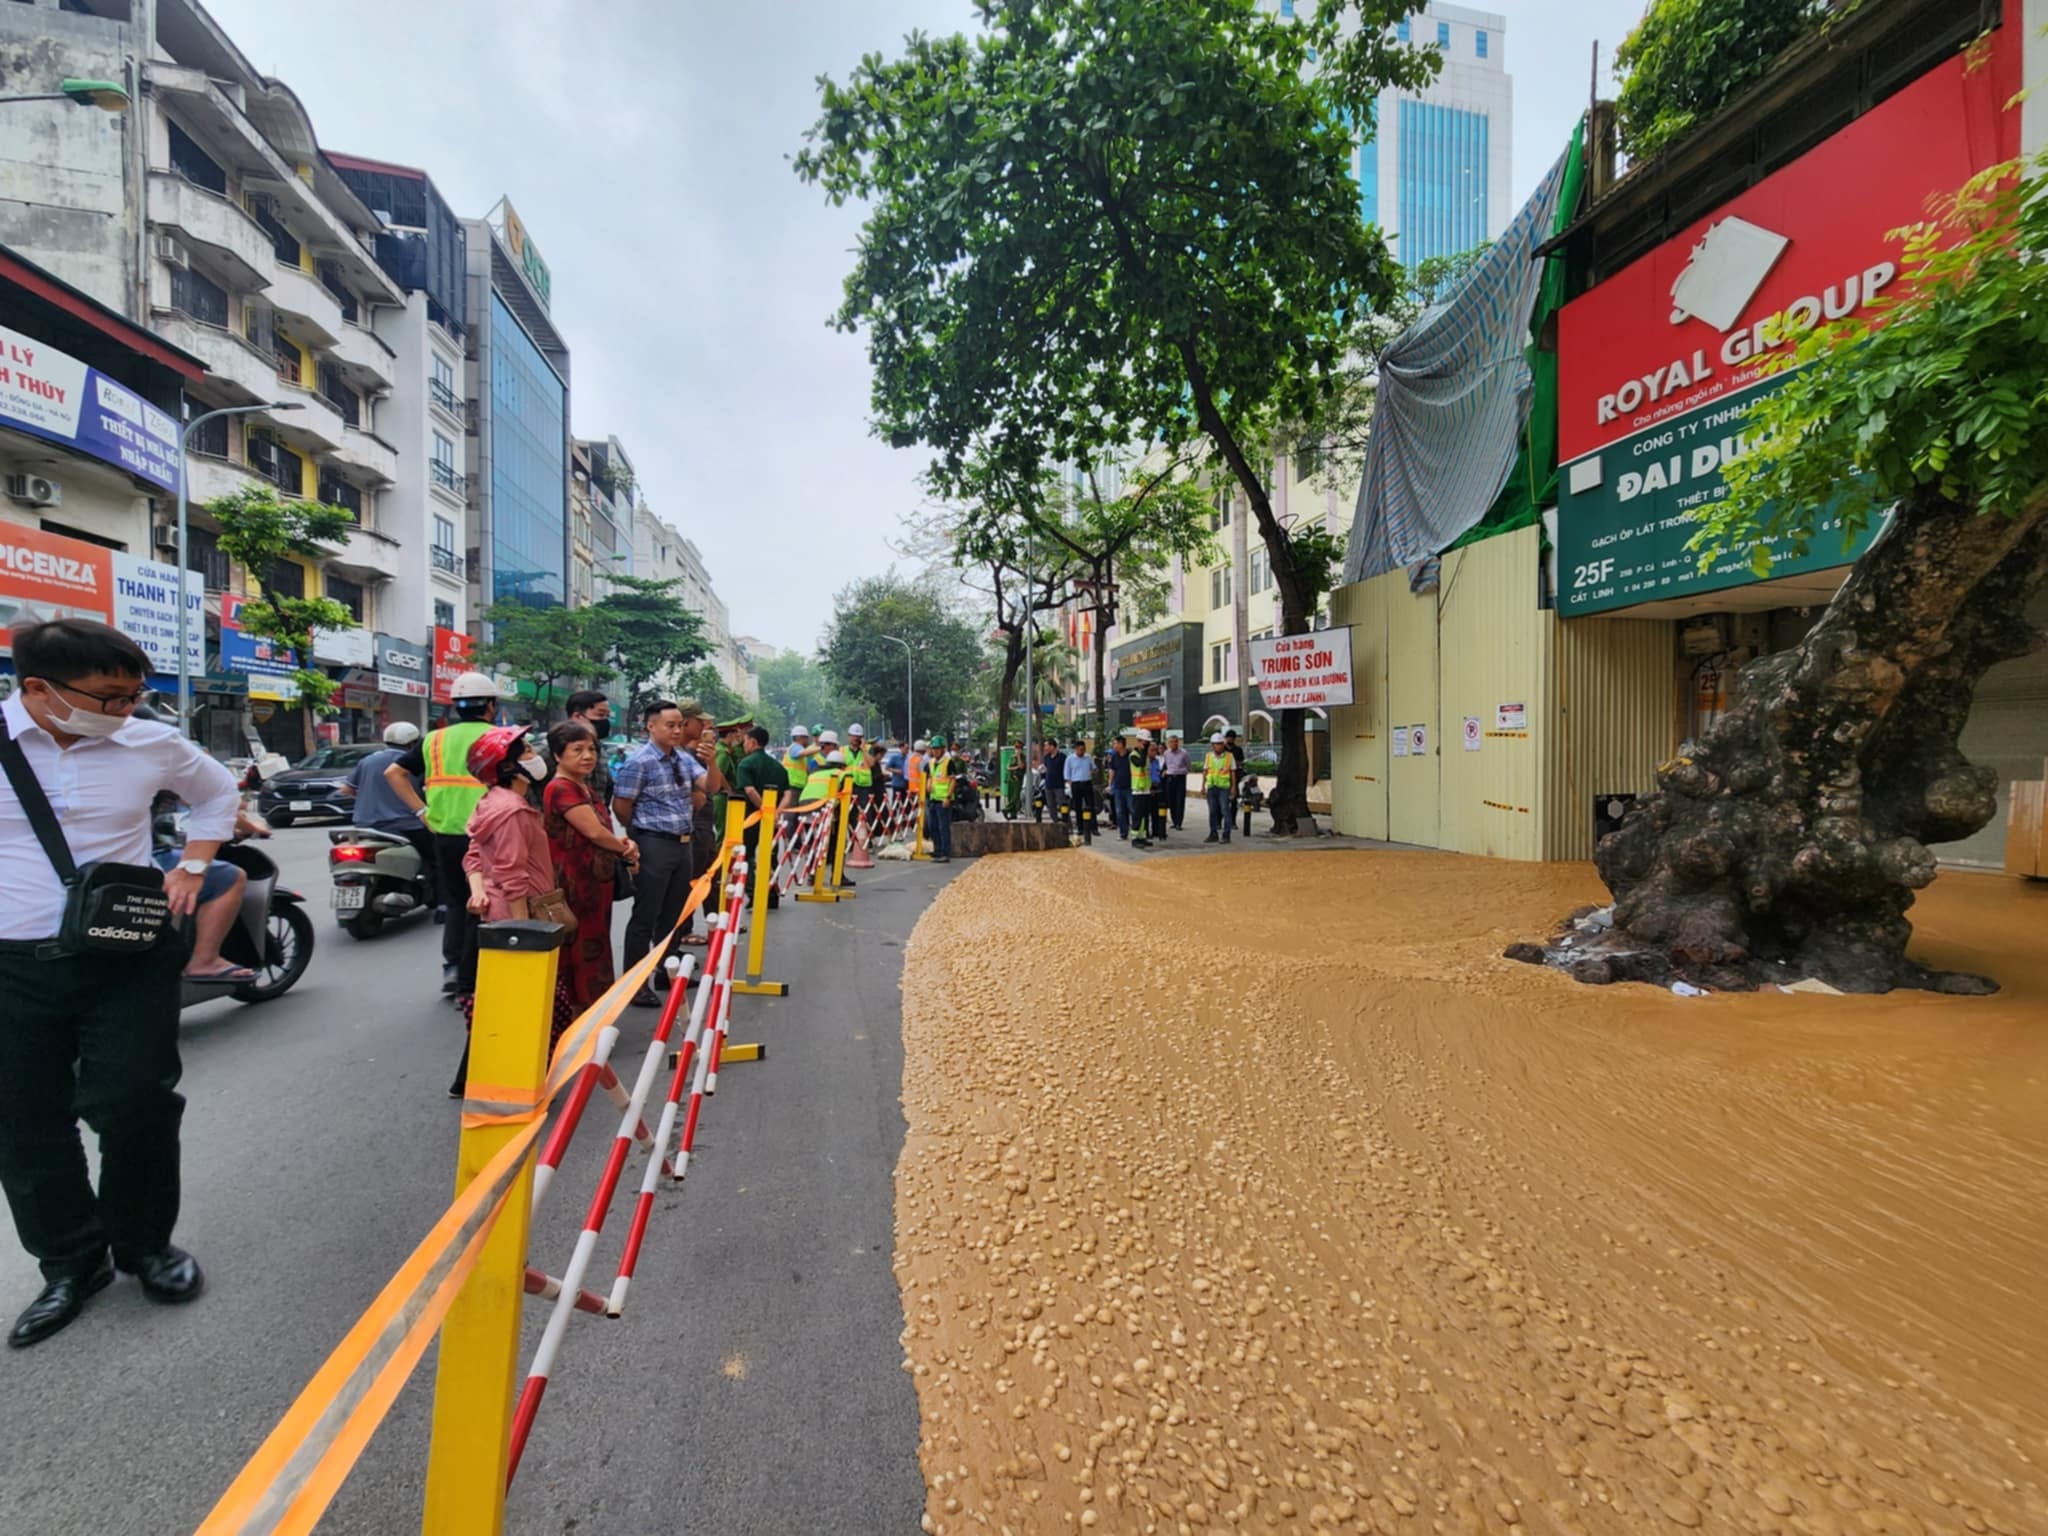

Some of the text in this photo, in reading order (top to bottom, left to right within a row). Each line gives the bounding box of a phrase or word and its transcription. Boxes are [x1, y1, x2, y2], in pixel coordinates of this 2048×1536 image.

[11, 344, 34, 367] LÝ
[1597, 261, 1896, 426] ROYAL GROUP
[16, 370, 65, 404] THÚY
[1678, 421, 1699, 440] TY
[1703, 402, 1748, 431] TNHH
[160, 570, 178, 585] HÀN
[1573, 558, 1615, 588] 25F
[117, 577, 166, 604] THANH
[1592, 587, 1614, 600] LINH
[1261, 650, 1333, 674] TRUNG SƠN
[88, 926, 140, 940] adidas
